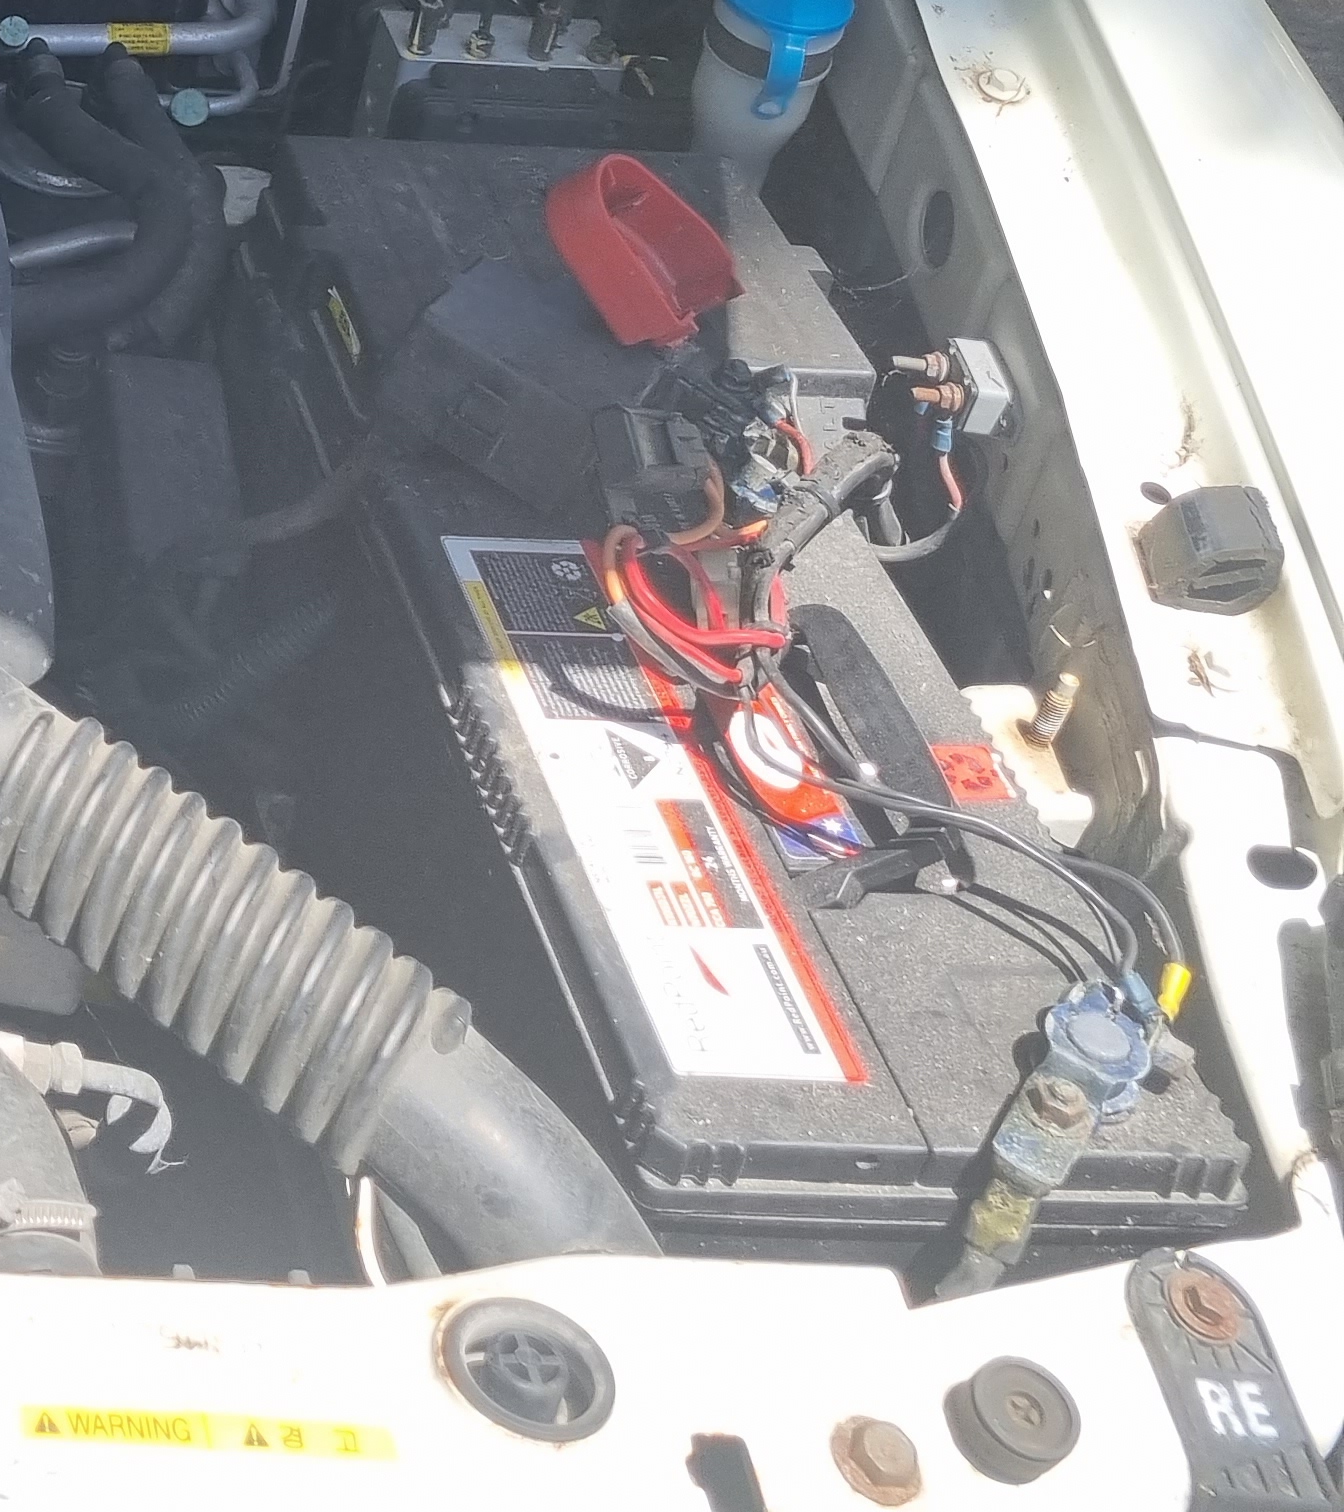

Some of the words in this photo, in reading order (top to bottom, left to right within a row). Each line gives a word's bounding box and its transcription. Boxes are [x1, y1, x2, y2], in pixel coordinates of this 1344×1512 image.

[611, 736, 639, 780] CORROSIVE
[64, 1411, 192, 1443] WARNING
[1195, 1377, 1280, 1439] RE
